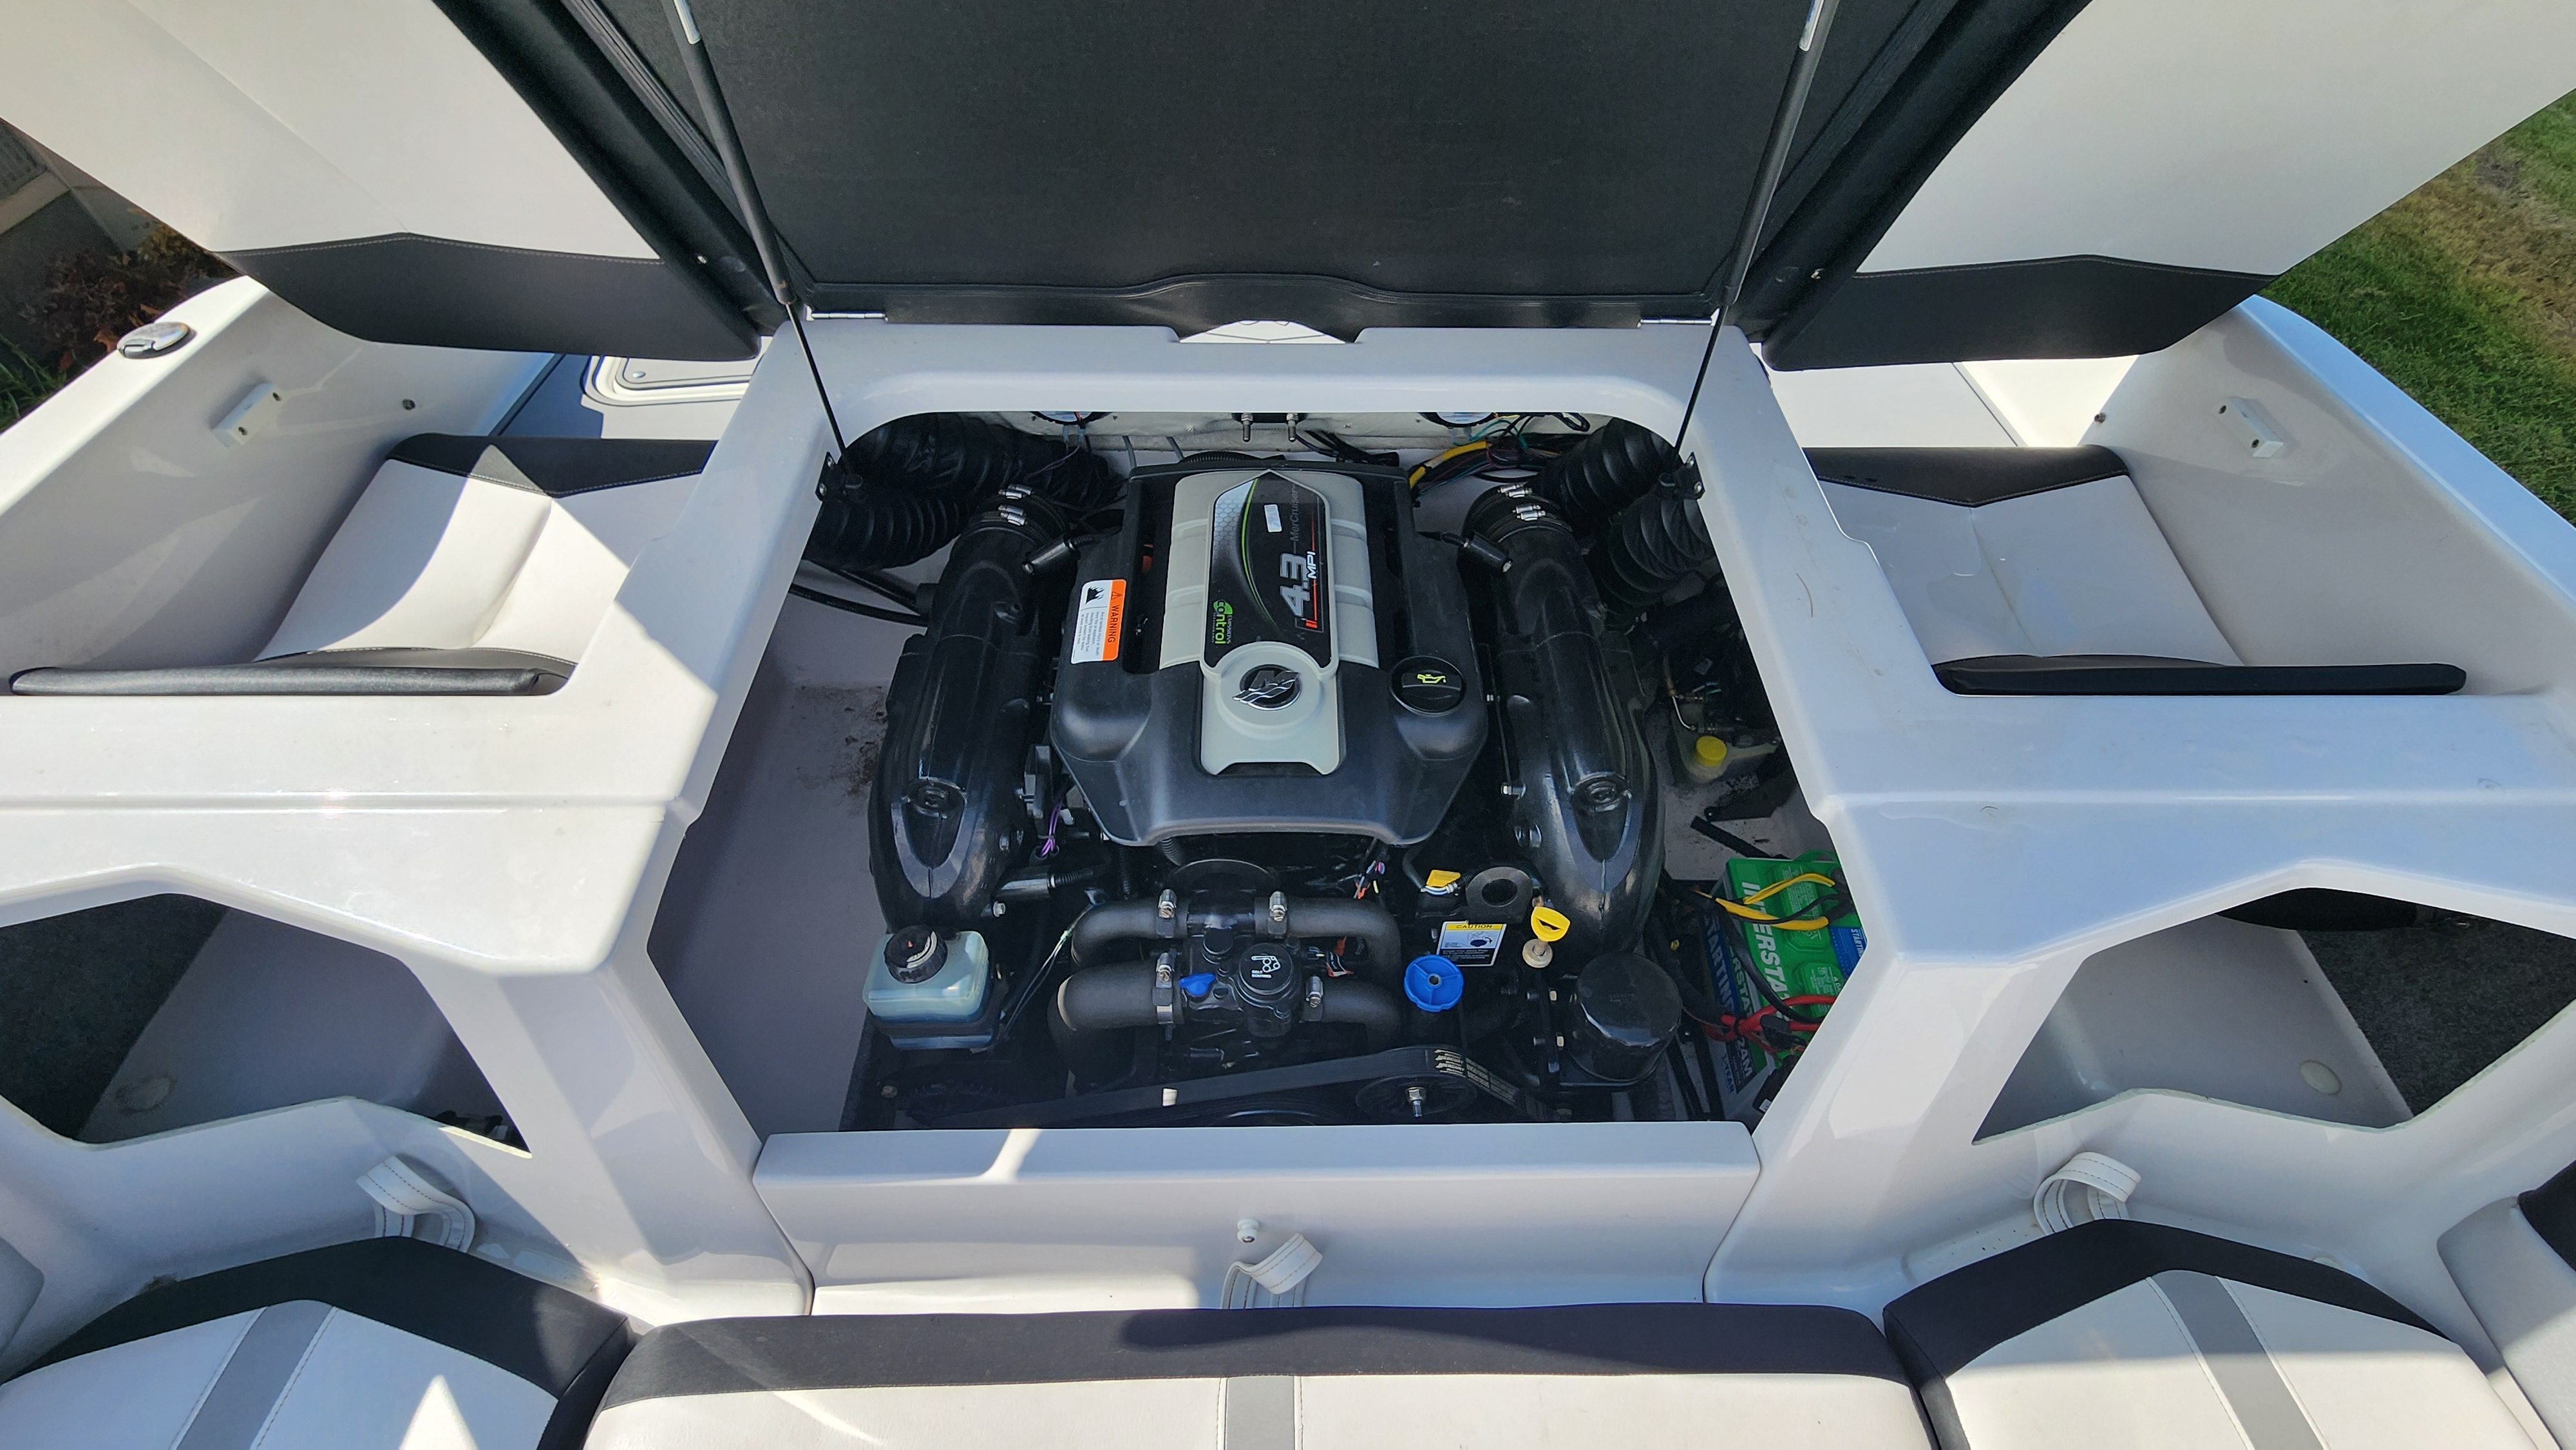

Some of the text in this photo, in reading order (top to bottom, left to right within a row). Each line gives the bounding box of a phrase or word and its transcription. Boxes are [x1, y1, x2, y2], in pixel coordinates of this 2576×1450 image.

[1290, 491, 1298, 541] MerCruiser
[1280, 553, 1309, 617] 4.3
[1307, 551, 1316, 579] MPI
[1108, 605, 1120, 643] WARNING
[1215, 600, 1227, 644] control
